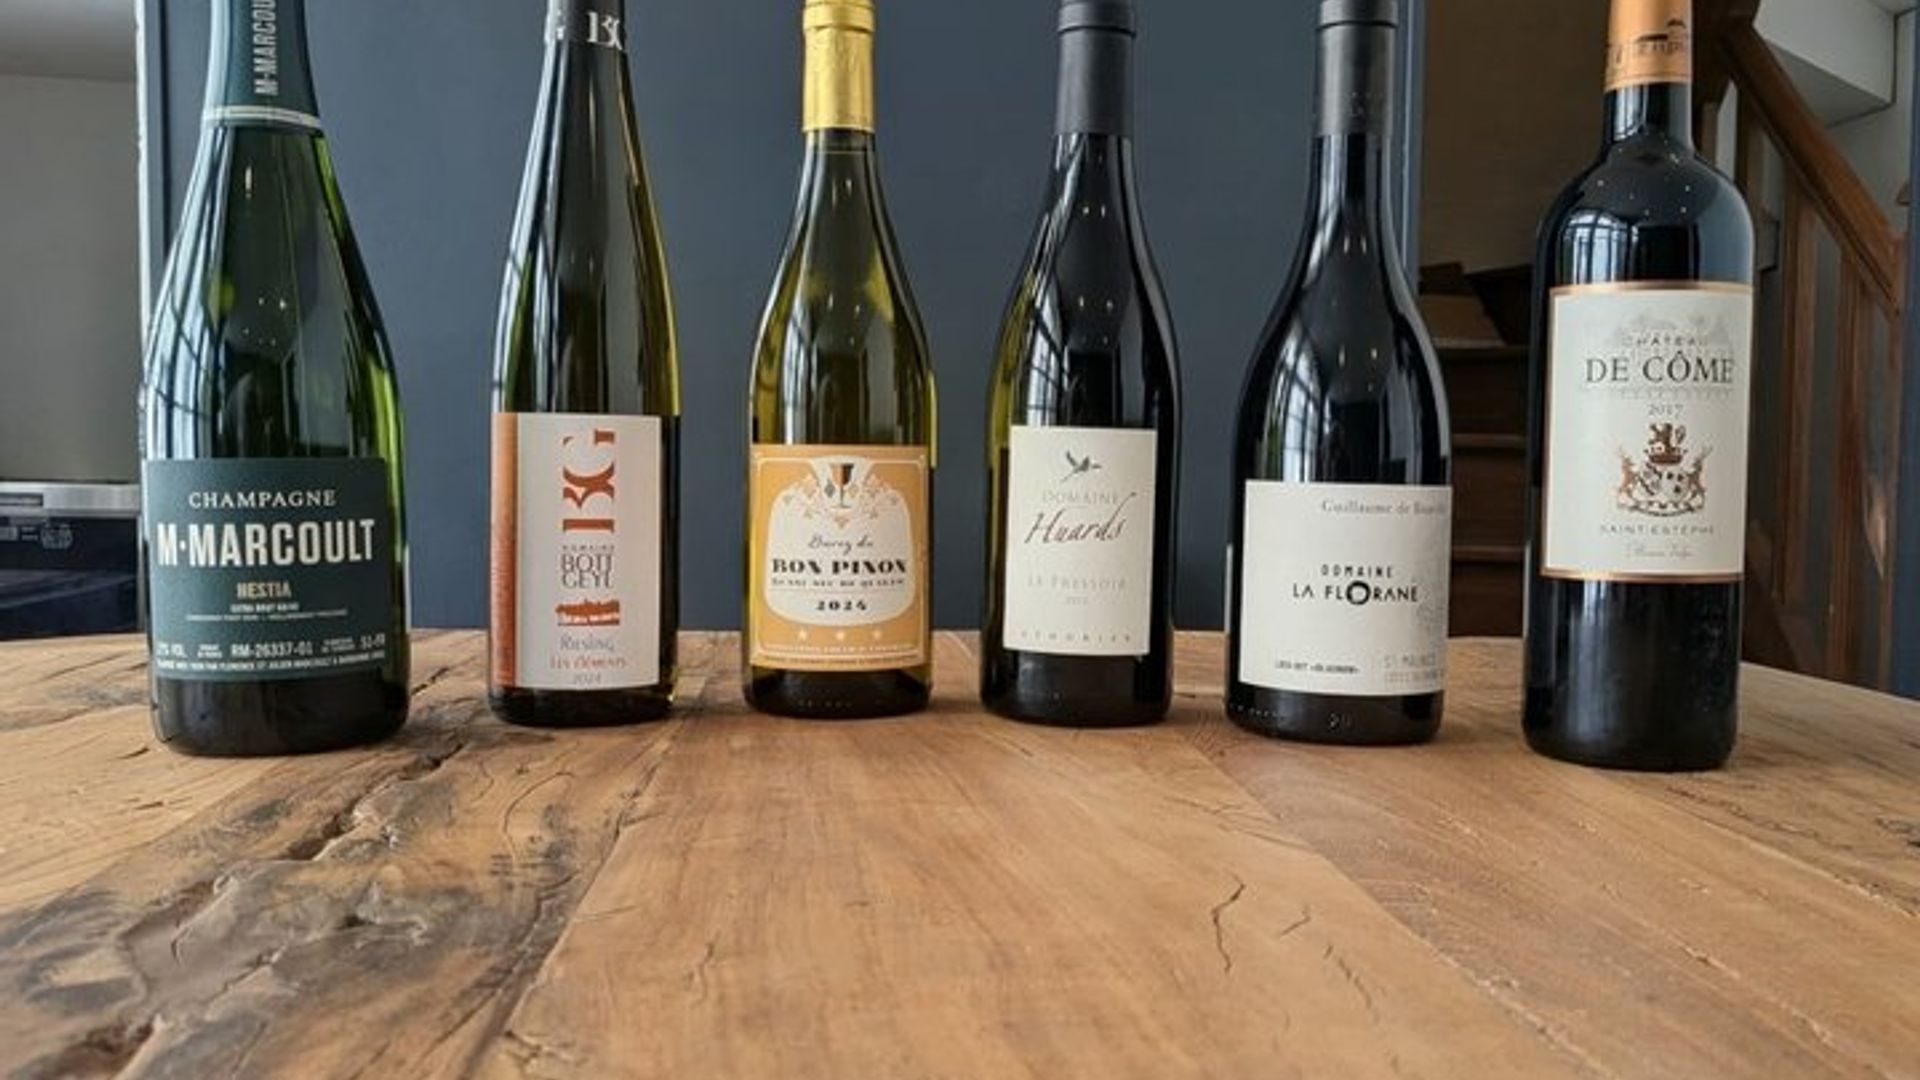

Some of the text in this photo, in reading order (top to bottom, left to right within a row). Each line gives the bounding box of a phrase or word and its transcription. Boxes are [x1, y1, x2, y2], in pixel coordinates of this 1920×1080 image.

[1585, 349, 1734, 384] DE CÔME
[188, 489, 337, 509] CHAMPAGNE
[1024, 491, 1138, 543] Huards
[772, 559, 906, 575] BON PINON
[1320, 563, 1394, 579] DOMAINE
[236, 581, 293, 600] HESTIA
[1292, 580, 1419, 606] LA FLORANE
